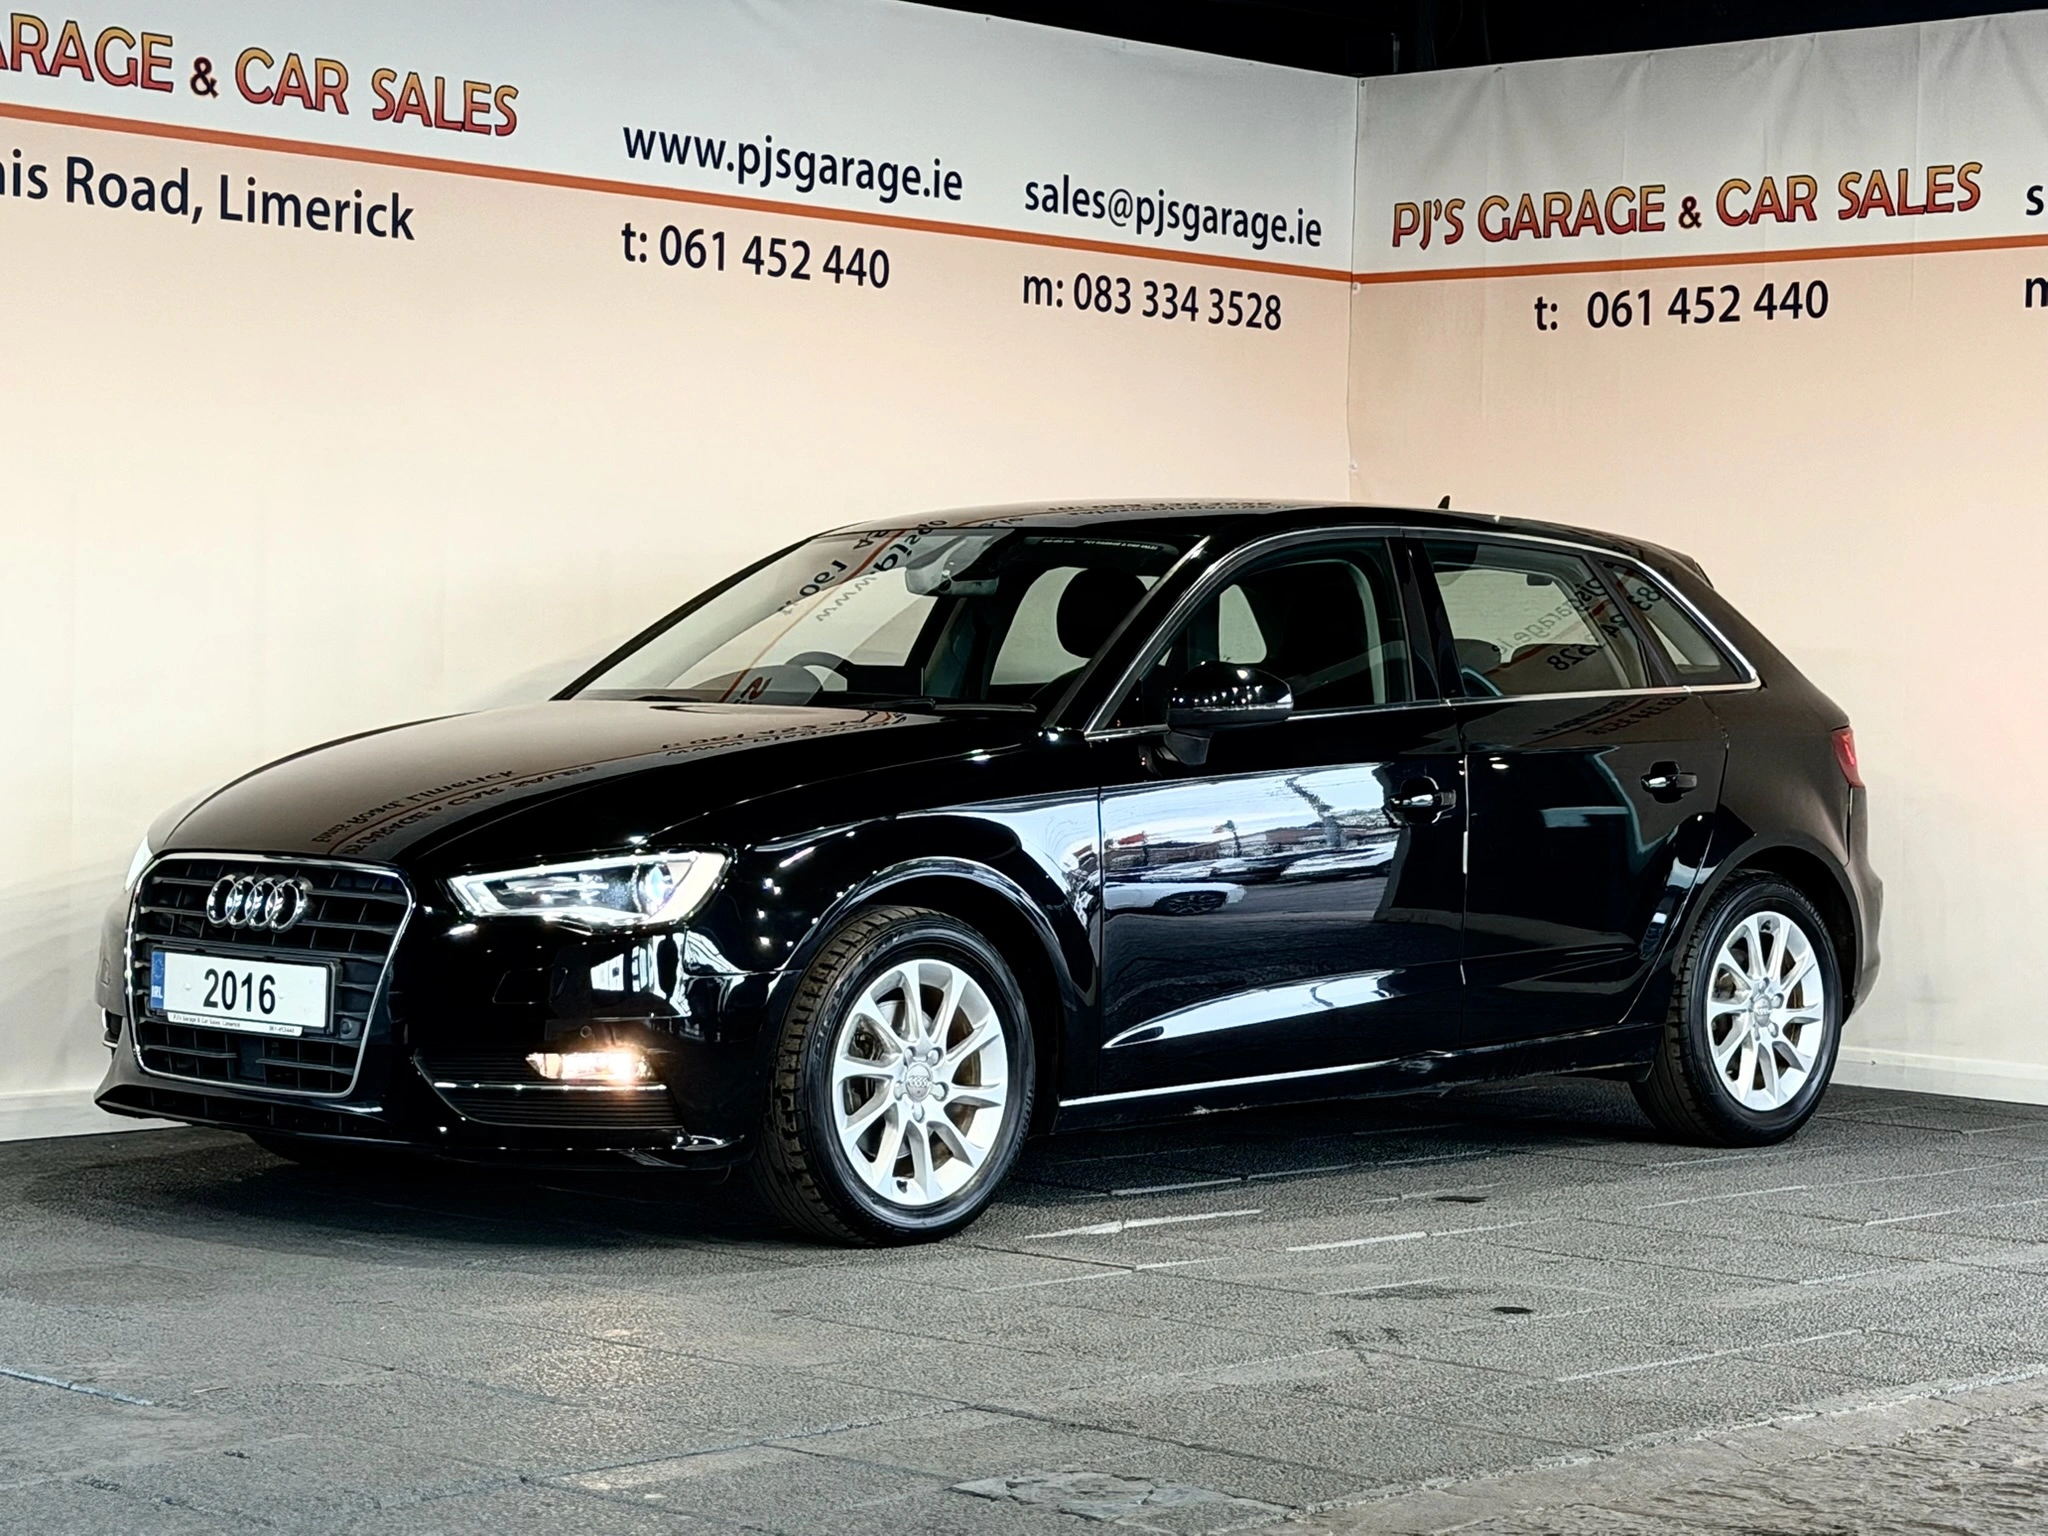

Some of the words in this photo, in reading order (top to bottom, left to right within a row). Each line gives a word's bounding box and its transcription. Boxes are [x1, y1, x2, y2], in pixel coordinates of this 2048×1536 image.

[0, 13, 174, 93] RAGE
[189, 57, 219, 99] &
[234, 46, 350, 116] CAR
[371, 67, 519, 137] SALES
[0, 148, 48, 200] is
[66, 156, 203, 225] Road,
[219, 174, 415, 241] Limerick
[622, 126, 963, 205] www.pjsgarage.ie
[1024, 174, 1322, 249] sales@pjsgarage.ie
[1391, 197, 1466, 251] PJ'S
[1477, 184, 1666, 243] GARAGE
[1678, 195, 1703, 230] &
[1716, 174, 1818, 228] CAR
[1837, 161, 1984, 220] SALES
[620, 222, 648, 264] t:
[659, 224, 727, 273] 061
[742, 235, 812, 282] 452
[822, 244, 890, 289] 440
[1023, 272, 1064, 309] m:
[1073, 272, 1132, 315] 083
[1141, 280, 1200, 322] 334
[1207, 287, 1282, 331] 3528
[1533, 296, 1558, 331] t:
[1587, 288, 1651, 329] 061
[1667, 284, 1741, 325] 452
[1753, 279, 1829, 321] 440
[203, 968, 277, 1016] 2016
